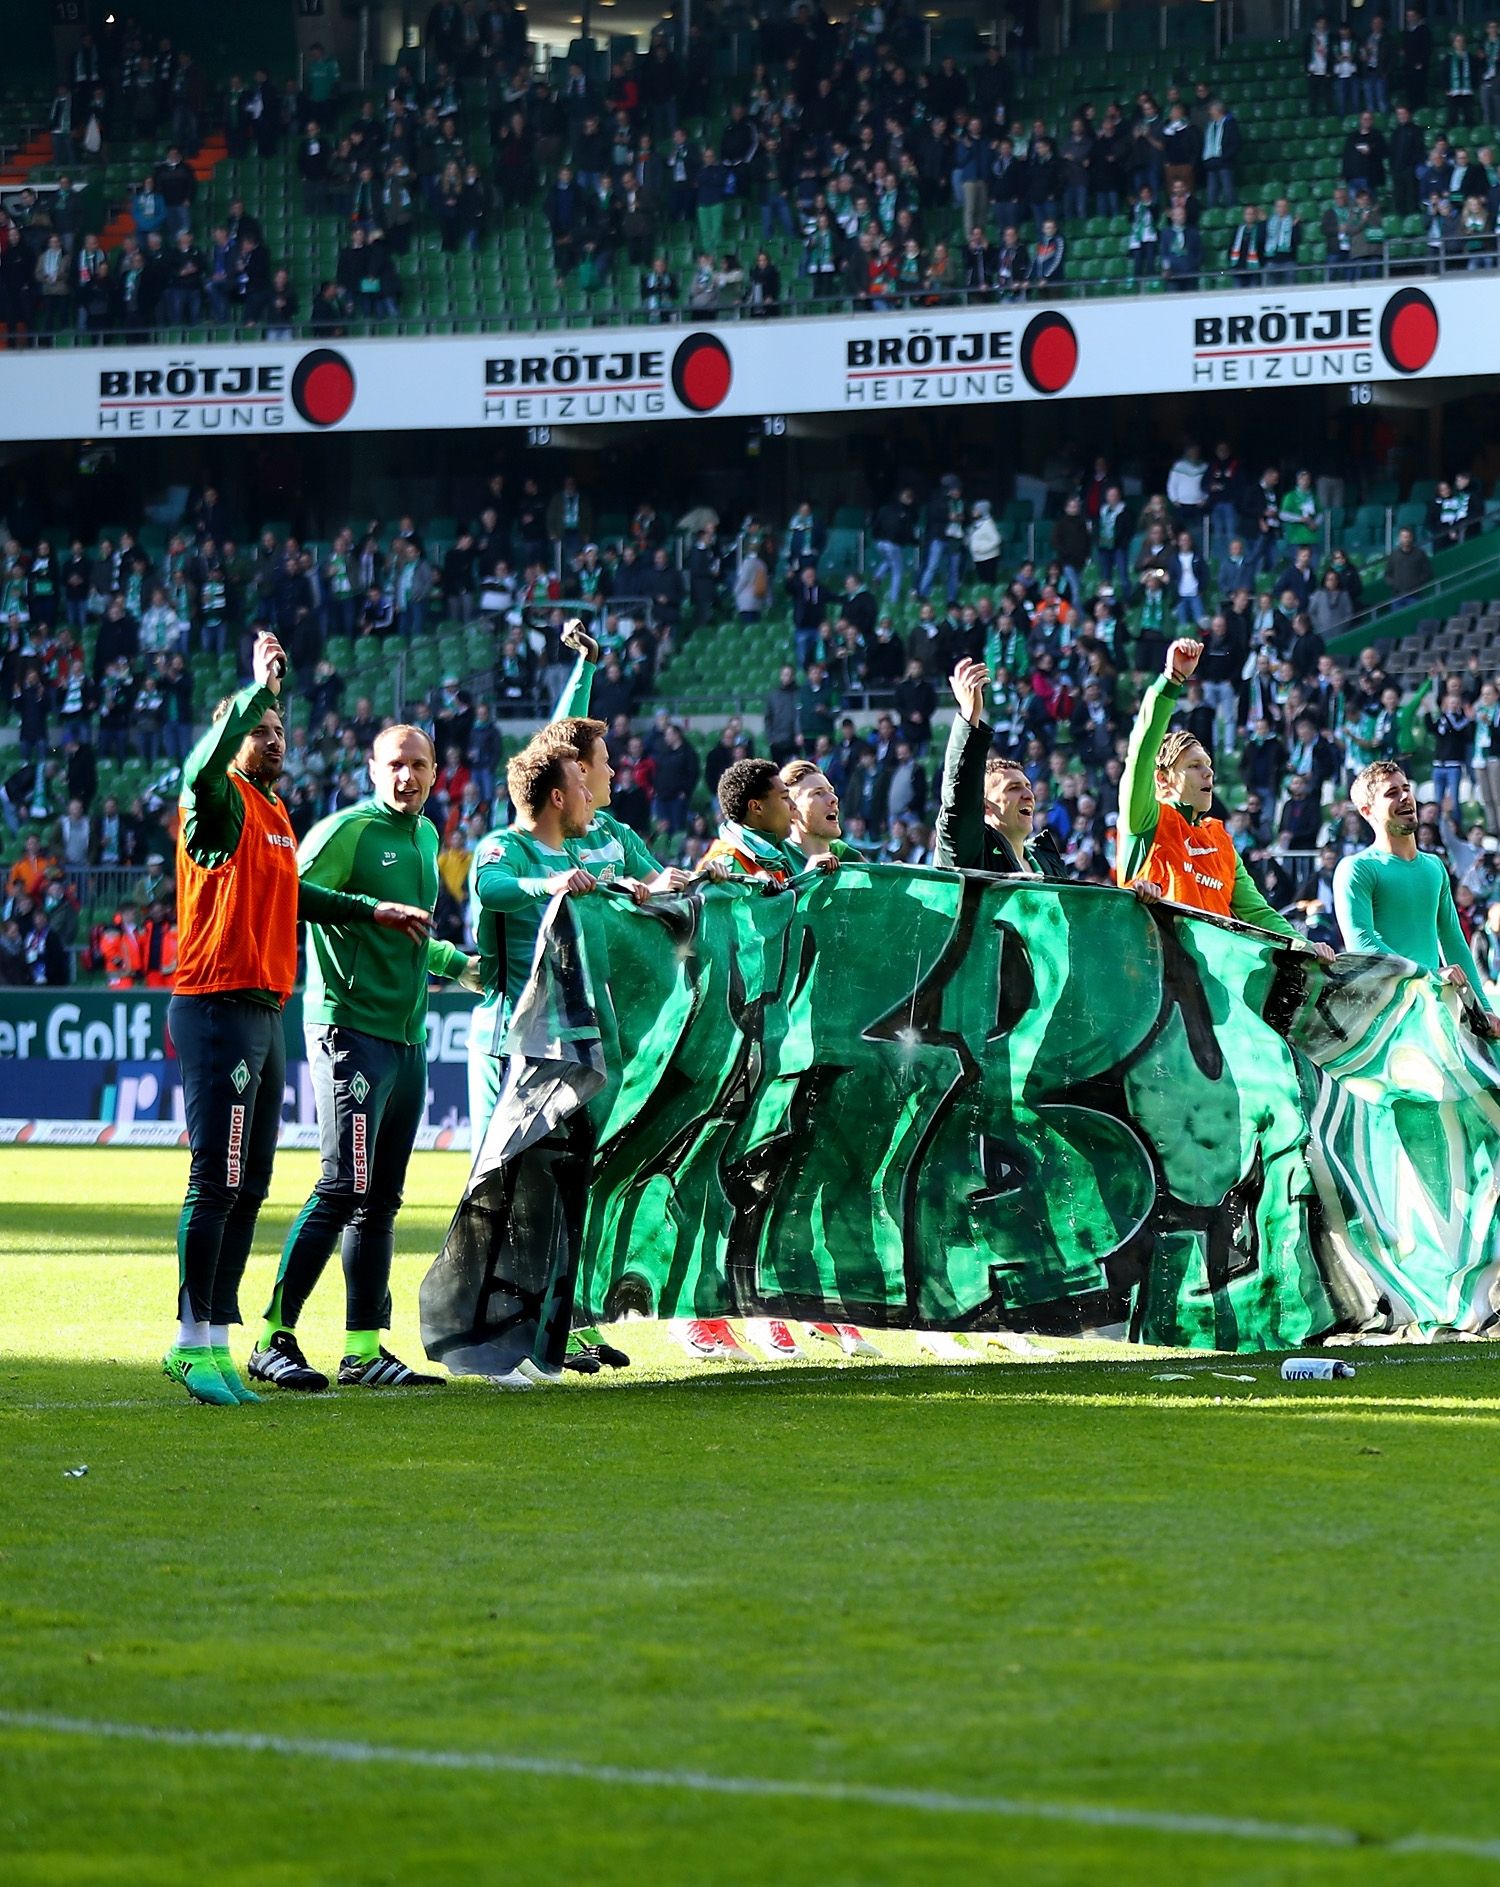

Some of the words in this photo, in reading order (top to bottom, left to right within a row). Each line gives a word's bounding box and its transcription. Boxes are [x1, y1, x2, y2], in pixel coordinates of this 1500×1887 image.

[1195, 306, 1373, 347] BRÖTJE
[485, 348, 664, 387] BRÖTJE
[847, 329, 1013, 368] BRÖTJE
[100, 362, 285, 399] BRÖTJE
[846, 373, 1014, 403] HEIZUNG
[1194, 353, 1374, 384] HEIZUNG
[98, 406, 285, 431] HEIZUNG
[484, 391, 665, 421] HEIZUNG
[46, 1003, 165, 1060] Golf.
[228, 1107, 243, 1185] WIESENHOF
[355, 1117, 366, 1191] WIESENHOF
